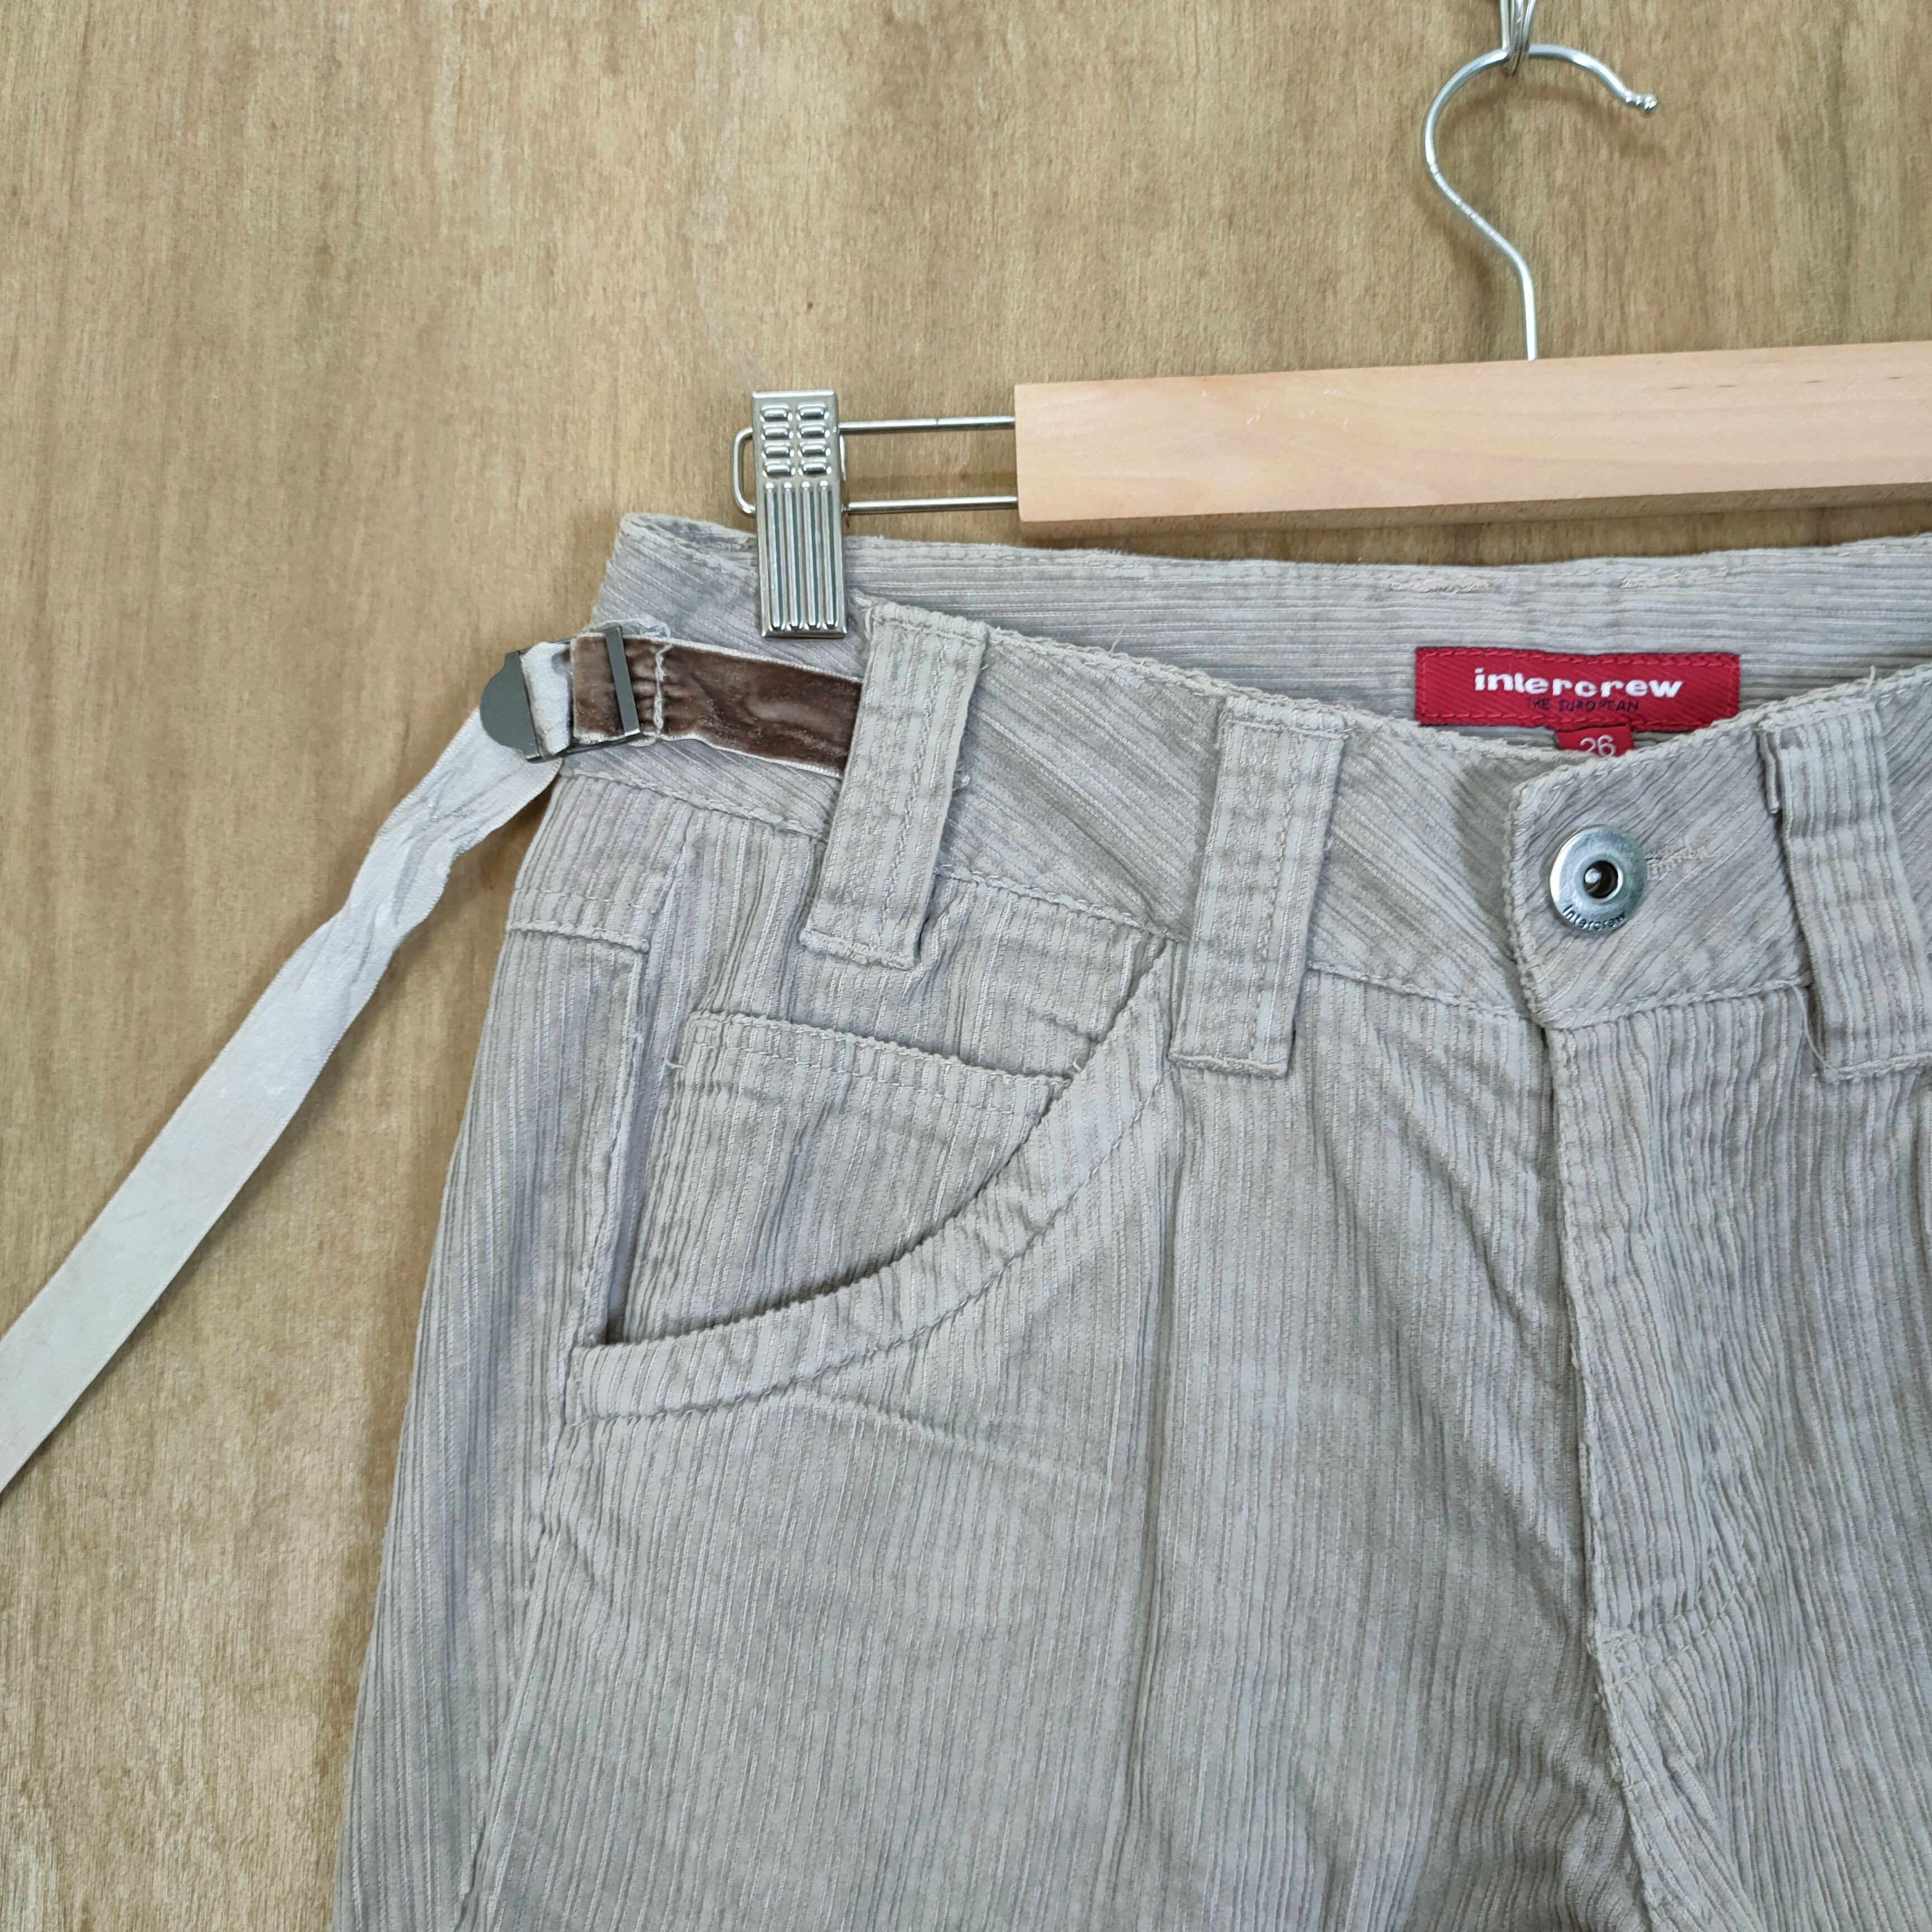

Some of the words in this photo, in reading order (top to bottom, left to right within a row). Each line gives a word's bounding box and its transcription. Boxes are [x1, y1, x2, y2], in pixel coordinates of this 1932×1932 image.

[1474, 667, 1684, 698] intercrew
[1527, 698, 1550, 711] THE
[1558, 699, 1639, 712] EUROPEAN
[1579, 734, 1617, 757] 26
